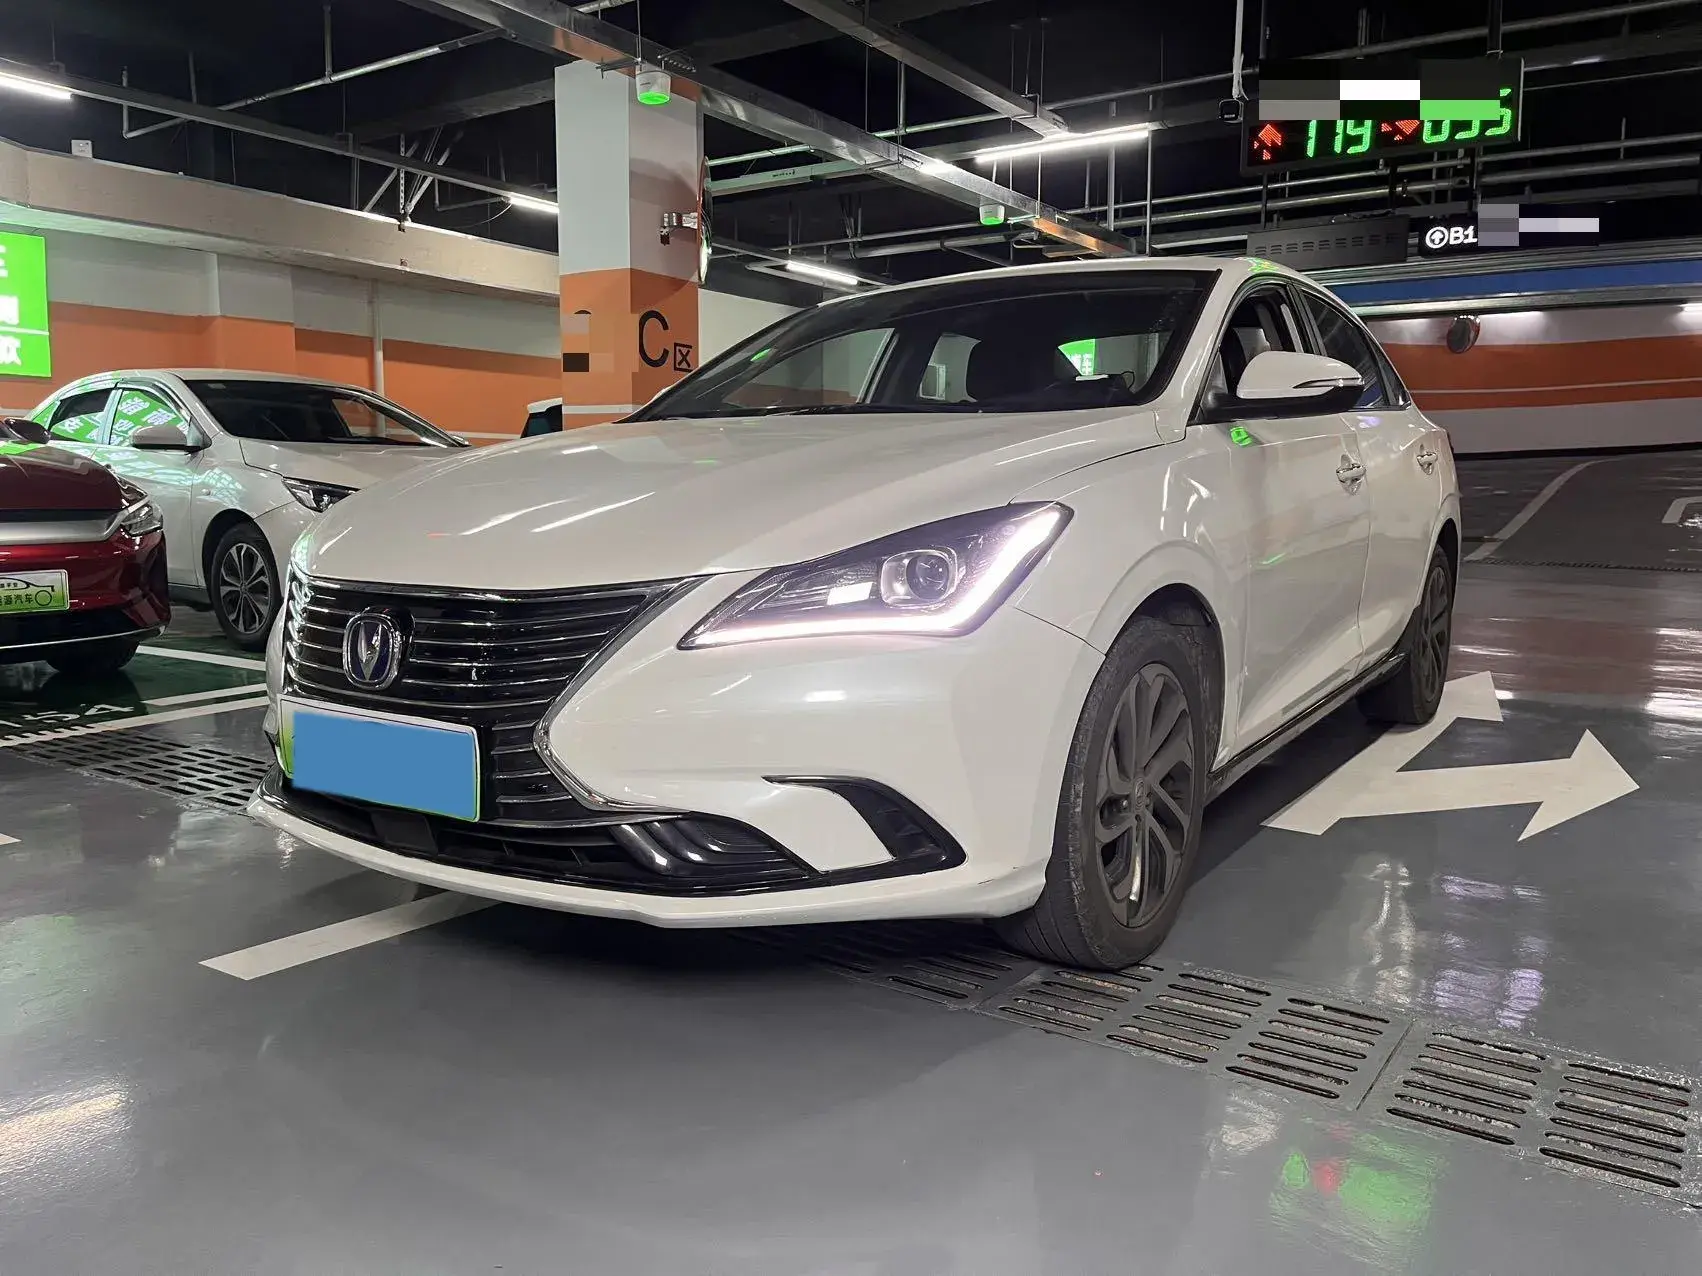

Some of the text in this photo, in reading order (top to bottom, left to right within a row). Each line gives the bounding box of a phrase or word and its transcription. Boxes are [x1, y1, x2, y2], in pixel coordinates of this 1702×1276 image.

[1449, 225, 1478, 245] B1
[0, 593, 34, 606] 源汽车
